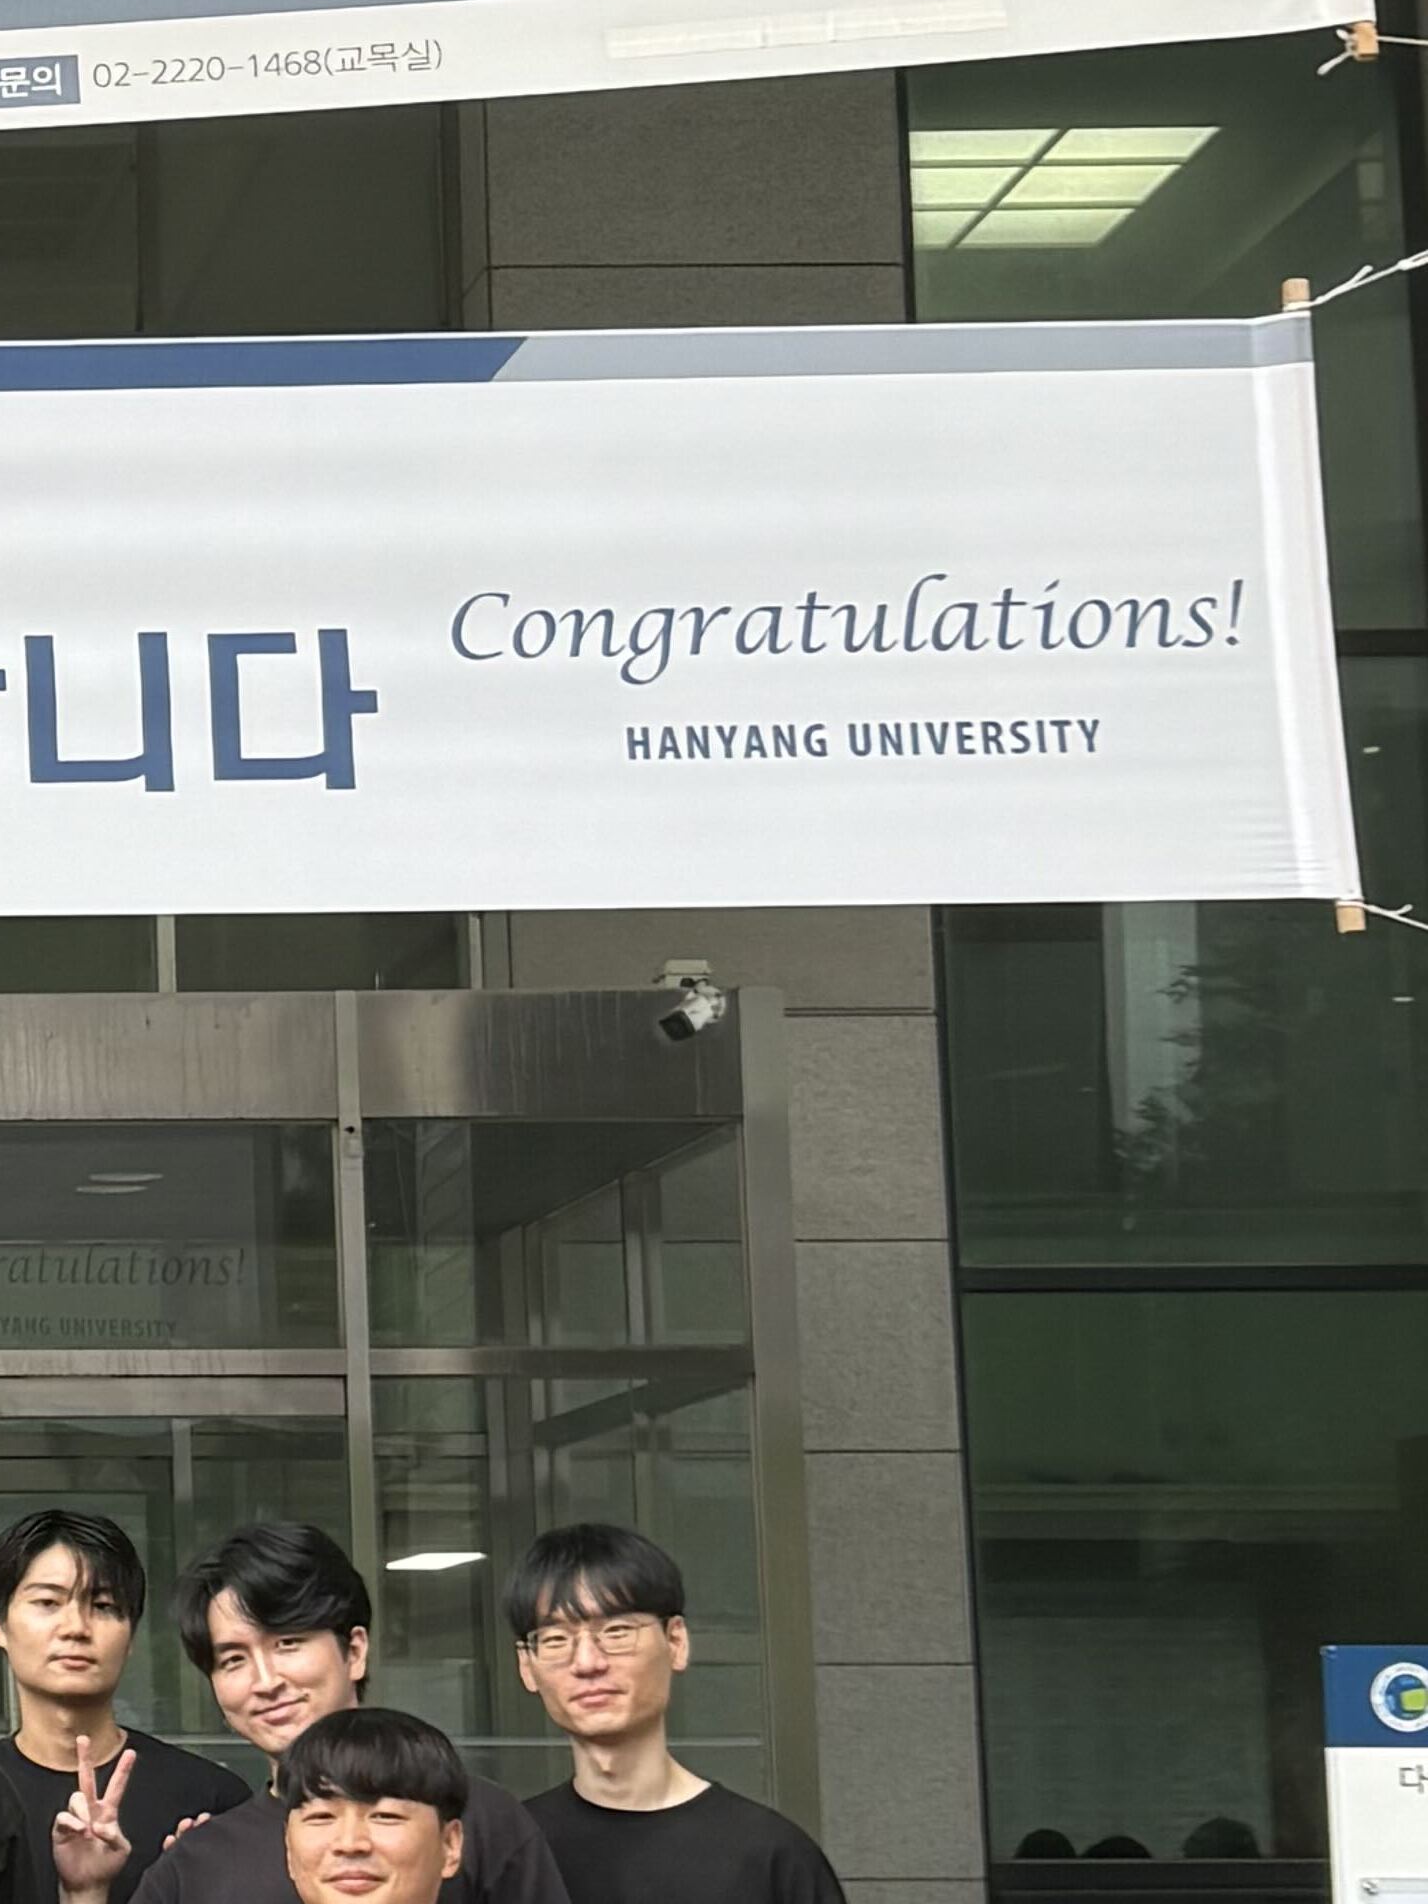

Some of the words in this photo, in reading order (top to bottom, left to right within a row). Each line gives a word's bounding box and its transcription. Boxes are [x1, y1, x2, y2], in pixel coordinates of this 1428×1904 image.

[92, 39, 443, 89] 02-2220-1468(교목실)
[451, 573, 1244, 686] Congratulations!
[626, 723, 829, 761] HANYANG
[847, 718, 1100, 757] UNIVERSITY
